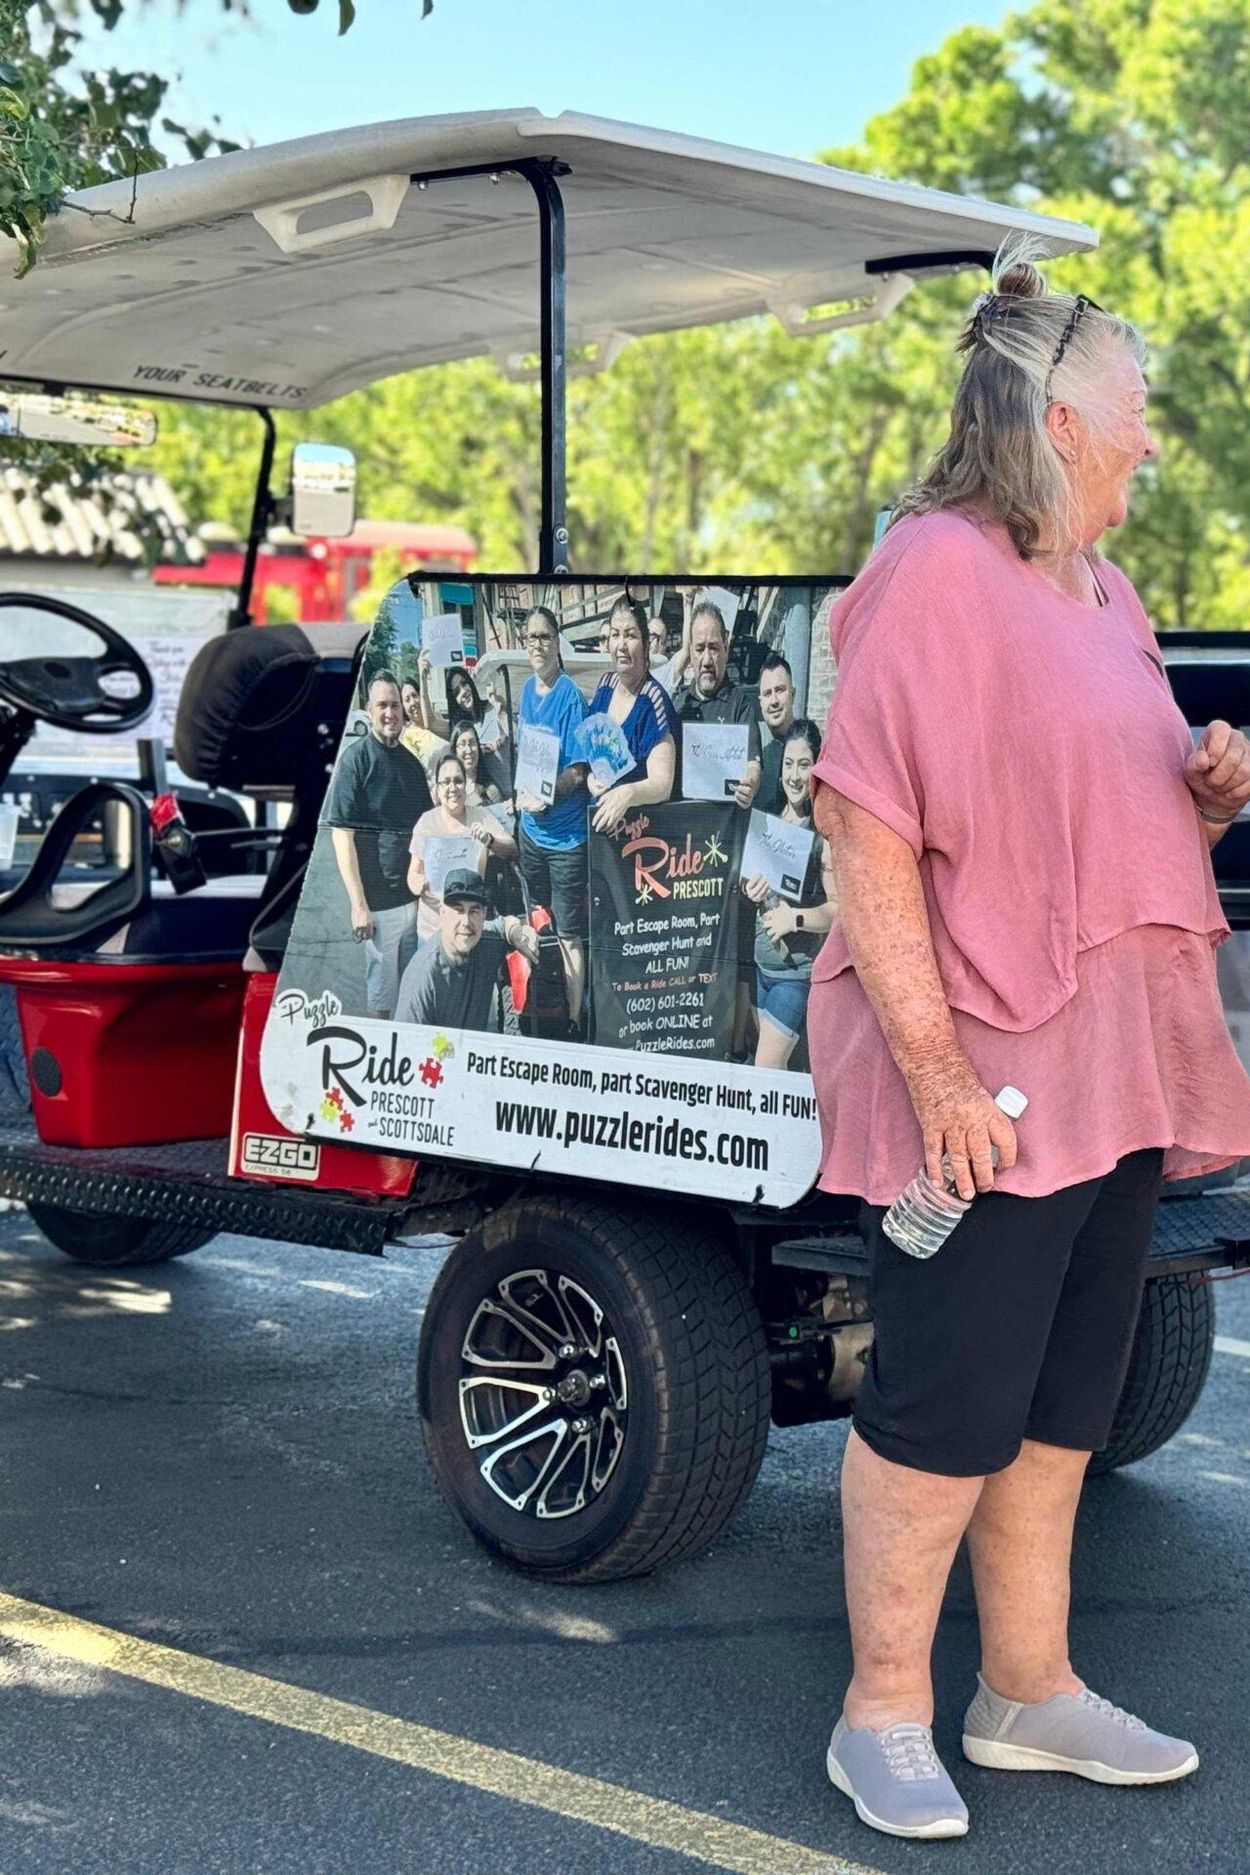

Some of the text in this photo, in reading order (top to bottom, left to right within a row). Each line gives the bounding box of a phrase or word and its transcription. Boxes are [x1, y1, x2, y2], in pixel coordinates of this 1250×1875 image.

[134, 365, 308, 398] YOUR SEATBELTS
[608, 813, 650, 841] Puzzle
[621, 833, 704, 898] Ride
[673, 877, 724, 900] PRESCOTT
[614, 912, 720, 935] Part Escape Room, Part
[622, 932, 712, 956] Scavenger Hunt and
[645, 960, 664, 974] ALL
[612, 982, 622, 991] To
[624, 981, 642, 991] Book
[650, 979, 667, 989] Ride
[668, 975, 687, 987] CALL
[698, 972, 718, 983] TEXT
[278, 993, 339, 1028] Puzzle
[626, 992, 705, 1015] (602) 601-2261
[618, 1014, 714, 1039] or book ONLINE at
[635, 1036, 715, 1053] PuzzleRides.com
[306, 1026, 415, 1108] Ride
[467, 1052, 818, 1121] Part Escape Room, part Scavenger Hunt, all FUN!
[370, 1091, 435, 1119] PRESCOTT
[379, 1117, 456, 1147] SCOTTSDALE
[495, 1101, 770, 1172] www.puzzlerides.com
[245, 1138, 317, 1169] EZGO
